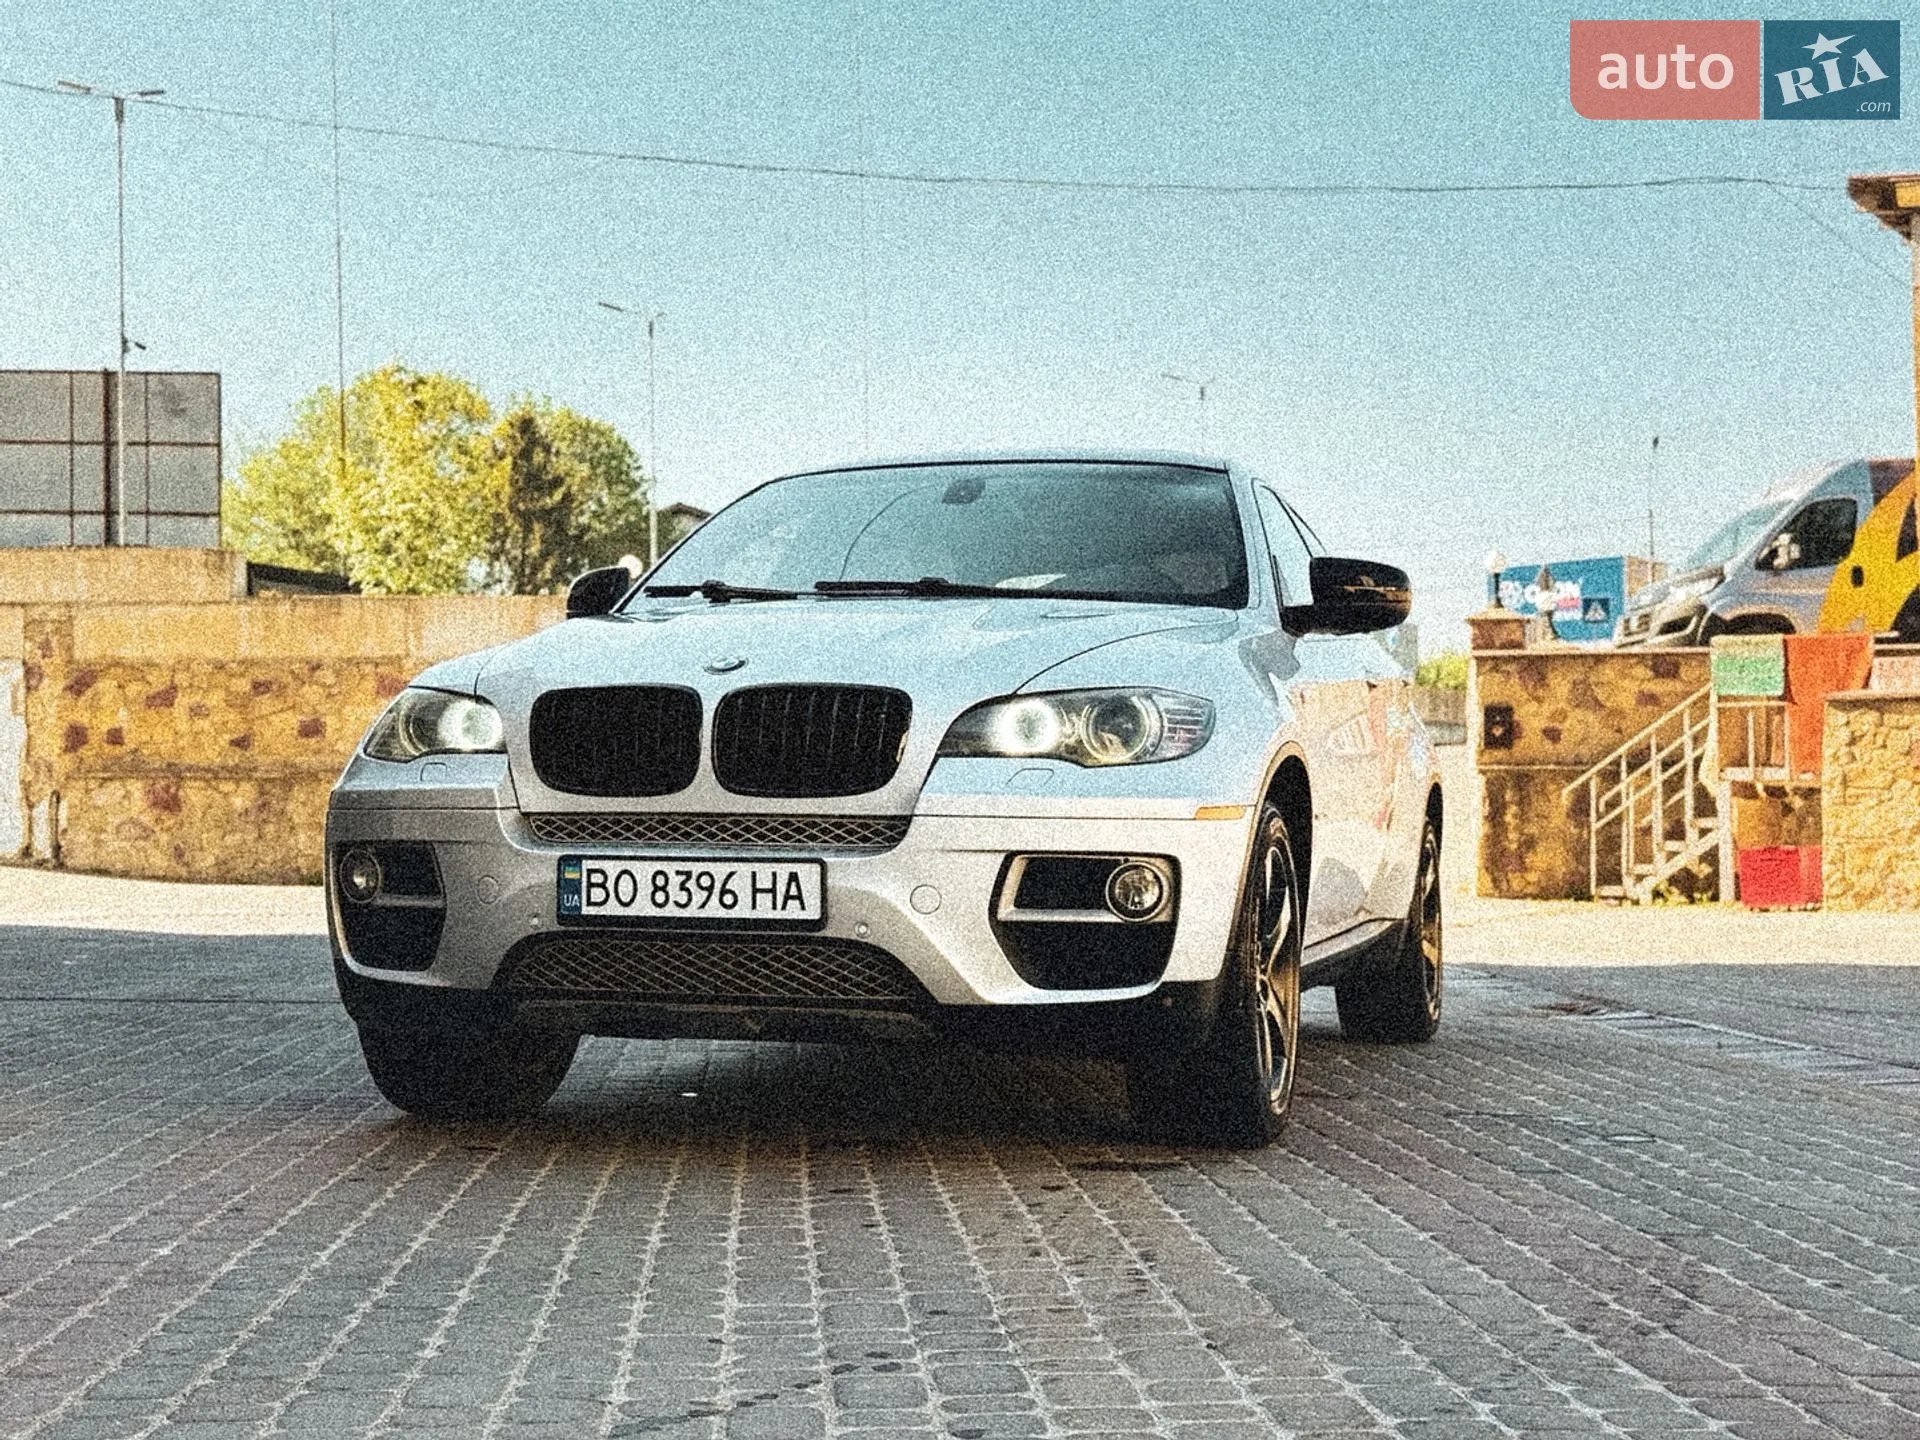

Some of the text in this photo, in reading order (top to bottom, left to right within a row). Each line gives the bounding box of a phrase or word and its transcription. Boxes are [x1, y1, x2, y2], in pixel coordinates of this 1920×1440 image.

[563, 894, 580, 907] UA
[585, 868, 807, 911] BO 8396 HA
